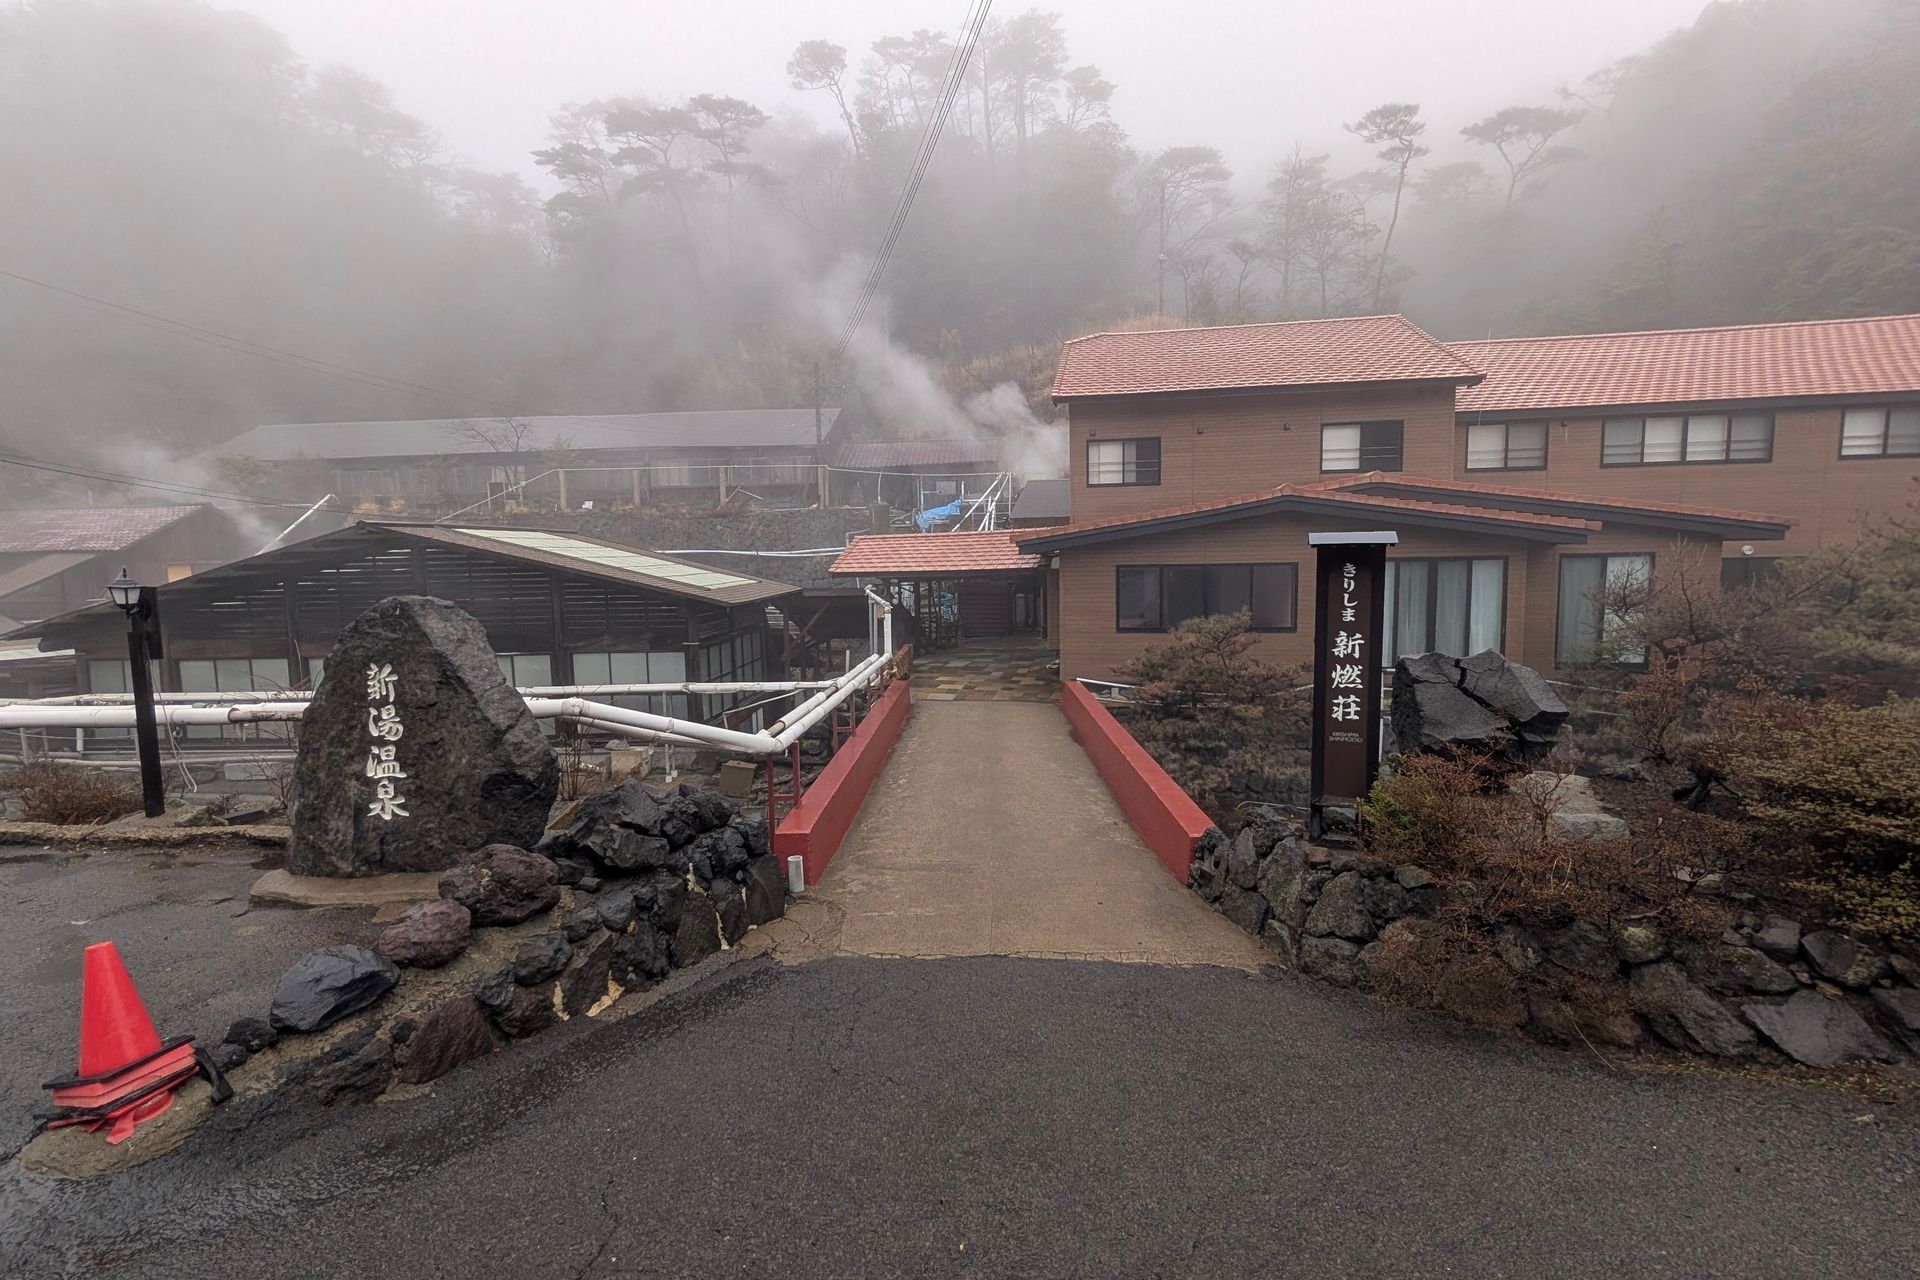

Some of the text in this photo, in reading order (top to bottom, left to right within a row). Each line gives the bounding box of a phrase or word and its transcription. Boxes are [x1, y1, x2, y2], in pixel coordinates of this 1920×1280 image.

[1331, 562, 1365, 721] きりしま 新燃荘
[366, 662, 410, 821] 新湯温泉
